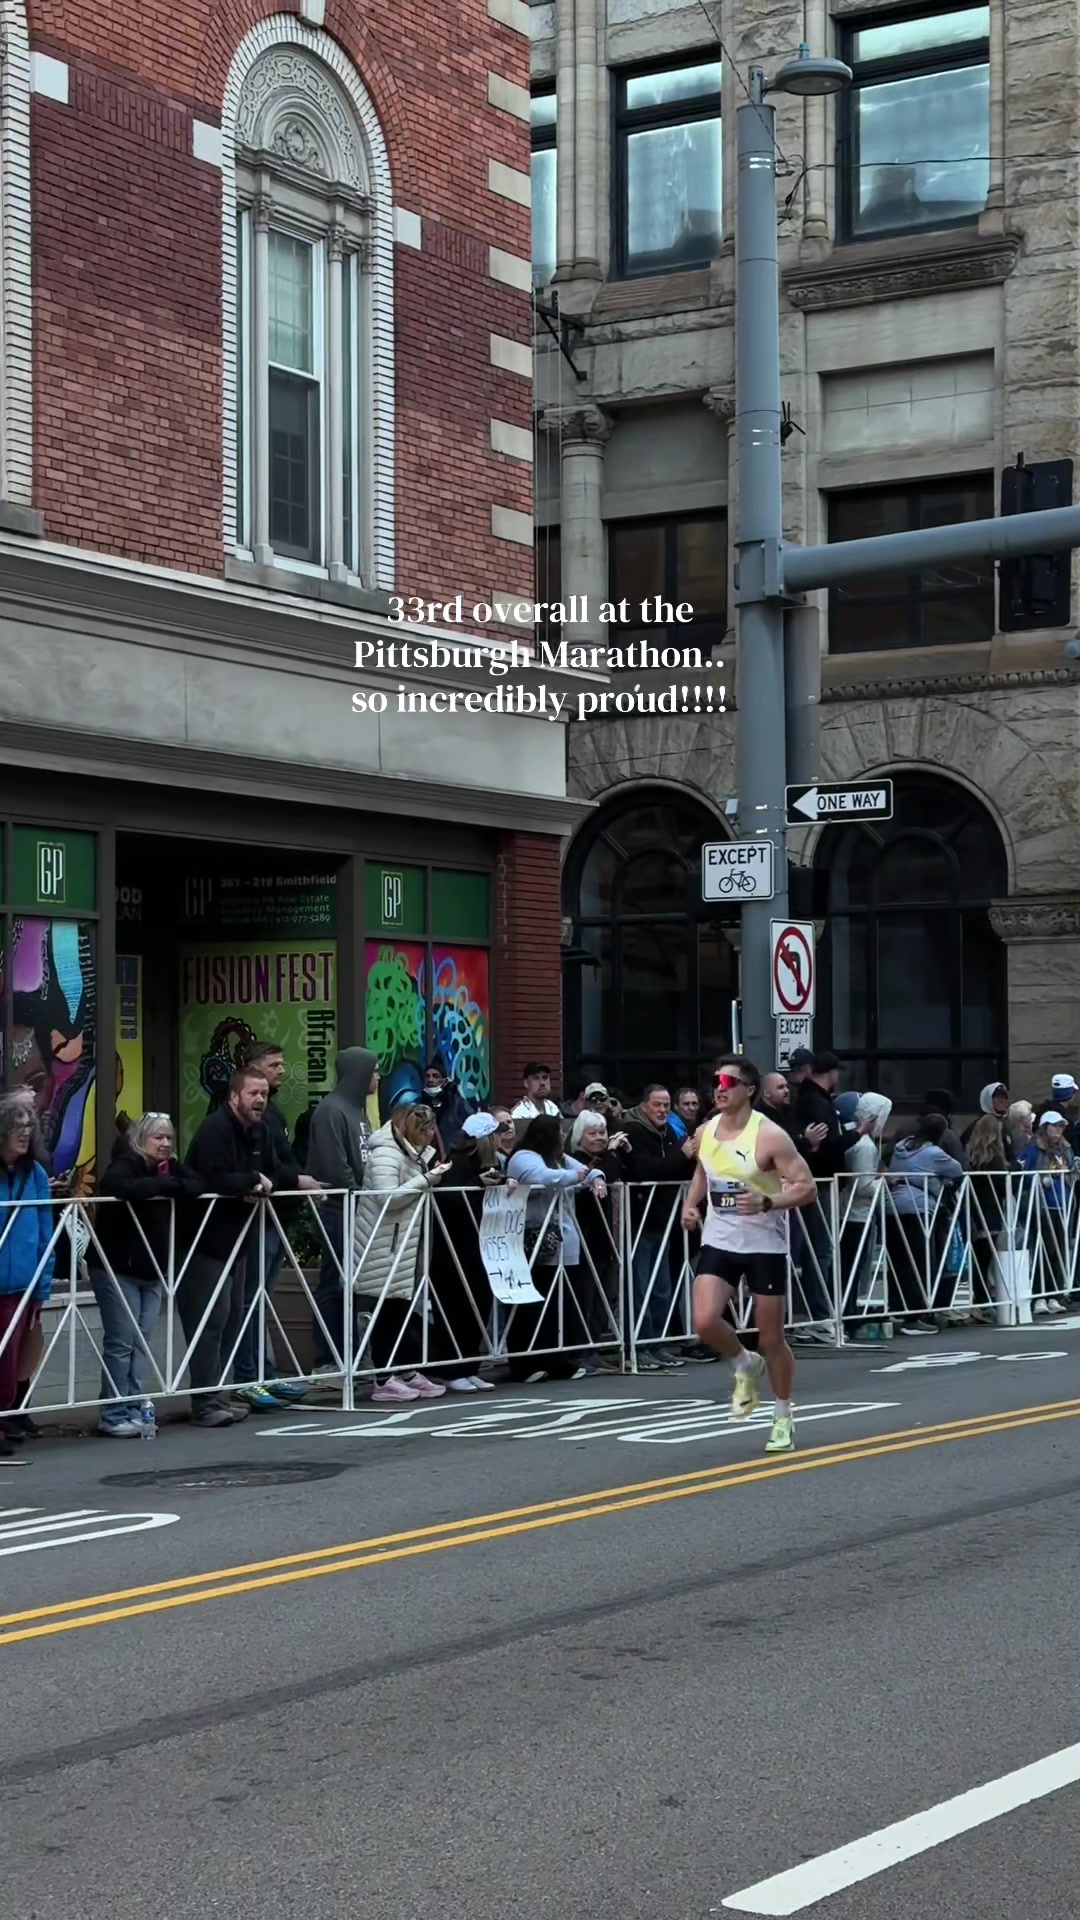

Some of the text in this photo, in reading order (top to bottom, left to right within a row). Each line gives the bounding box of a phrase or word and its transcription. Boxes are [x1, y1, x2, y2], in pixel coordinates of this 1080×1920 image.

[817, 792, 880, 811] ONE WAY
[41, 847, 63, 895] GP
[708, 847, 767, 865] EXCEPT
[275, 874, 337, 887] Smithfield
[384, 876, 401, 918] GP
[183, 954, 269, 1006] FUSION
[276, 952, 334, 1003] FEST
[780, 1019, 809, 1034] EXCEPT
[306, 1009, 335, 1083] African
